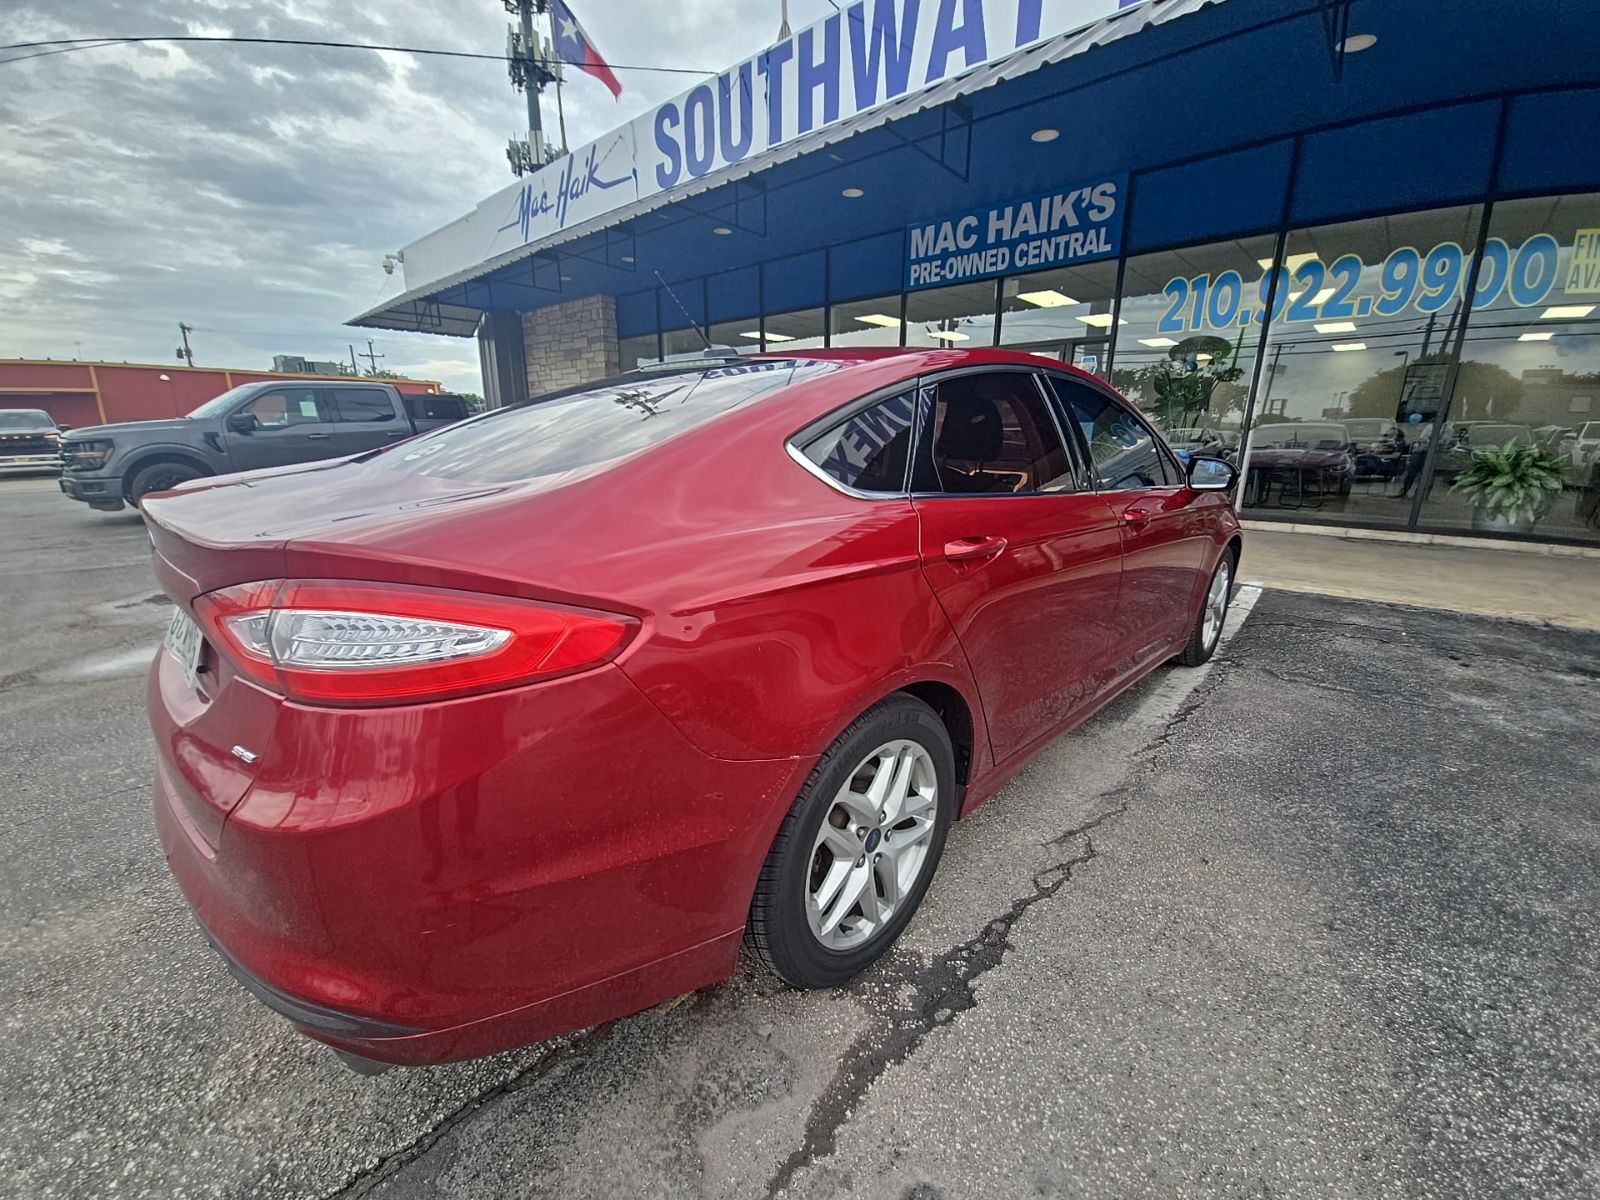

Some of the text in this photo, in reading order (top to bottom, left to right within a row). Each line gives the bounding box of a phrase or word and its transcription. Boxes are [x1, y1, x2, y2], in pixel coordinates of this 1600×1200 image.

[497, 143, 632, 243] Mac Haik
[910, 182, 1117, 260] MAC HAIK'S
[910, 226, 1113, 287] PRE-OWNED CENTRAL
[1157, 232, 1560, 335] 210.922.9900
